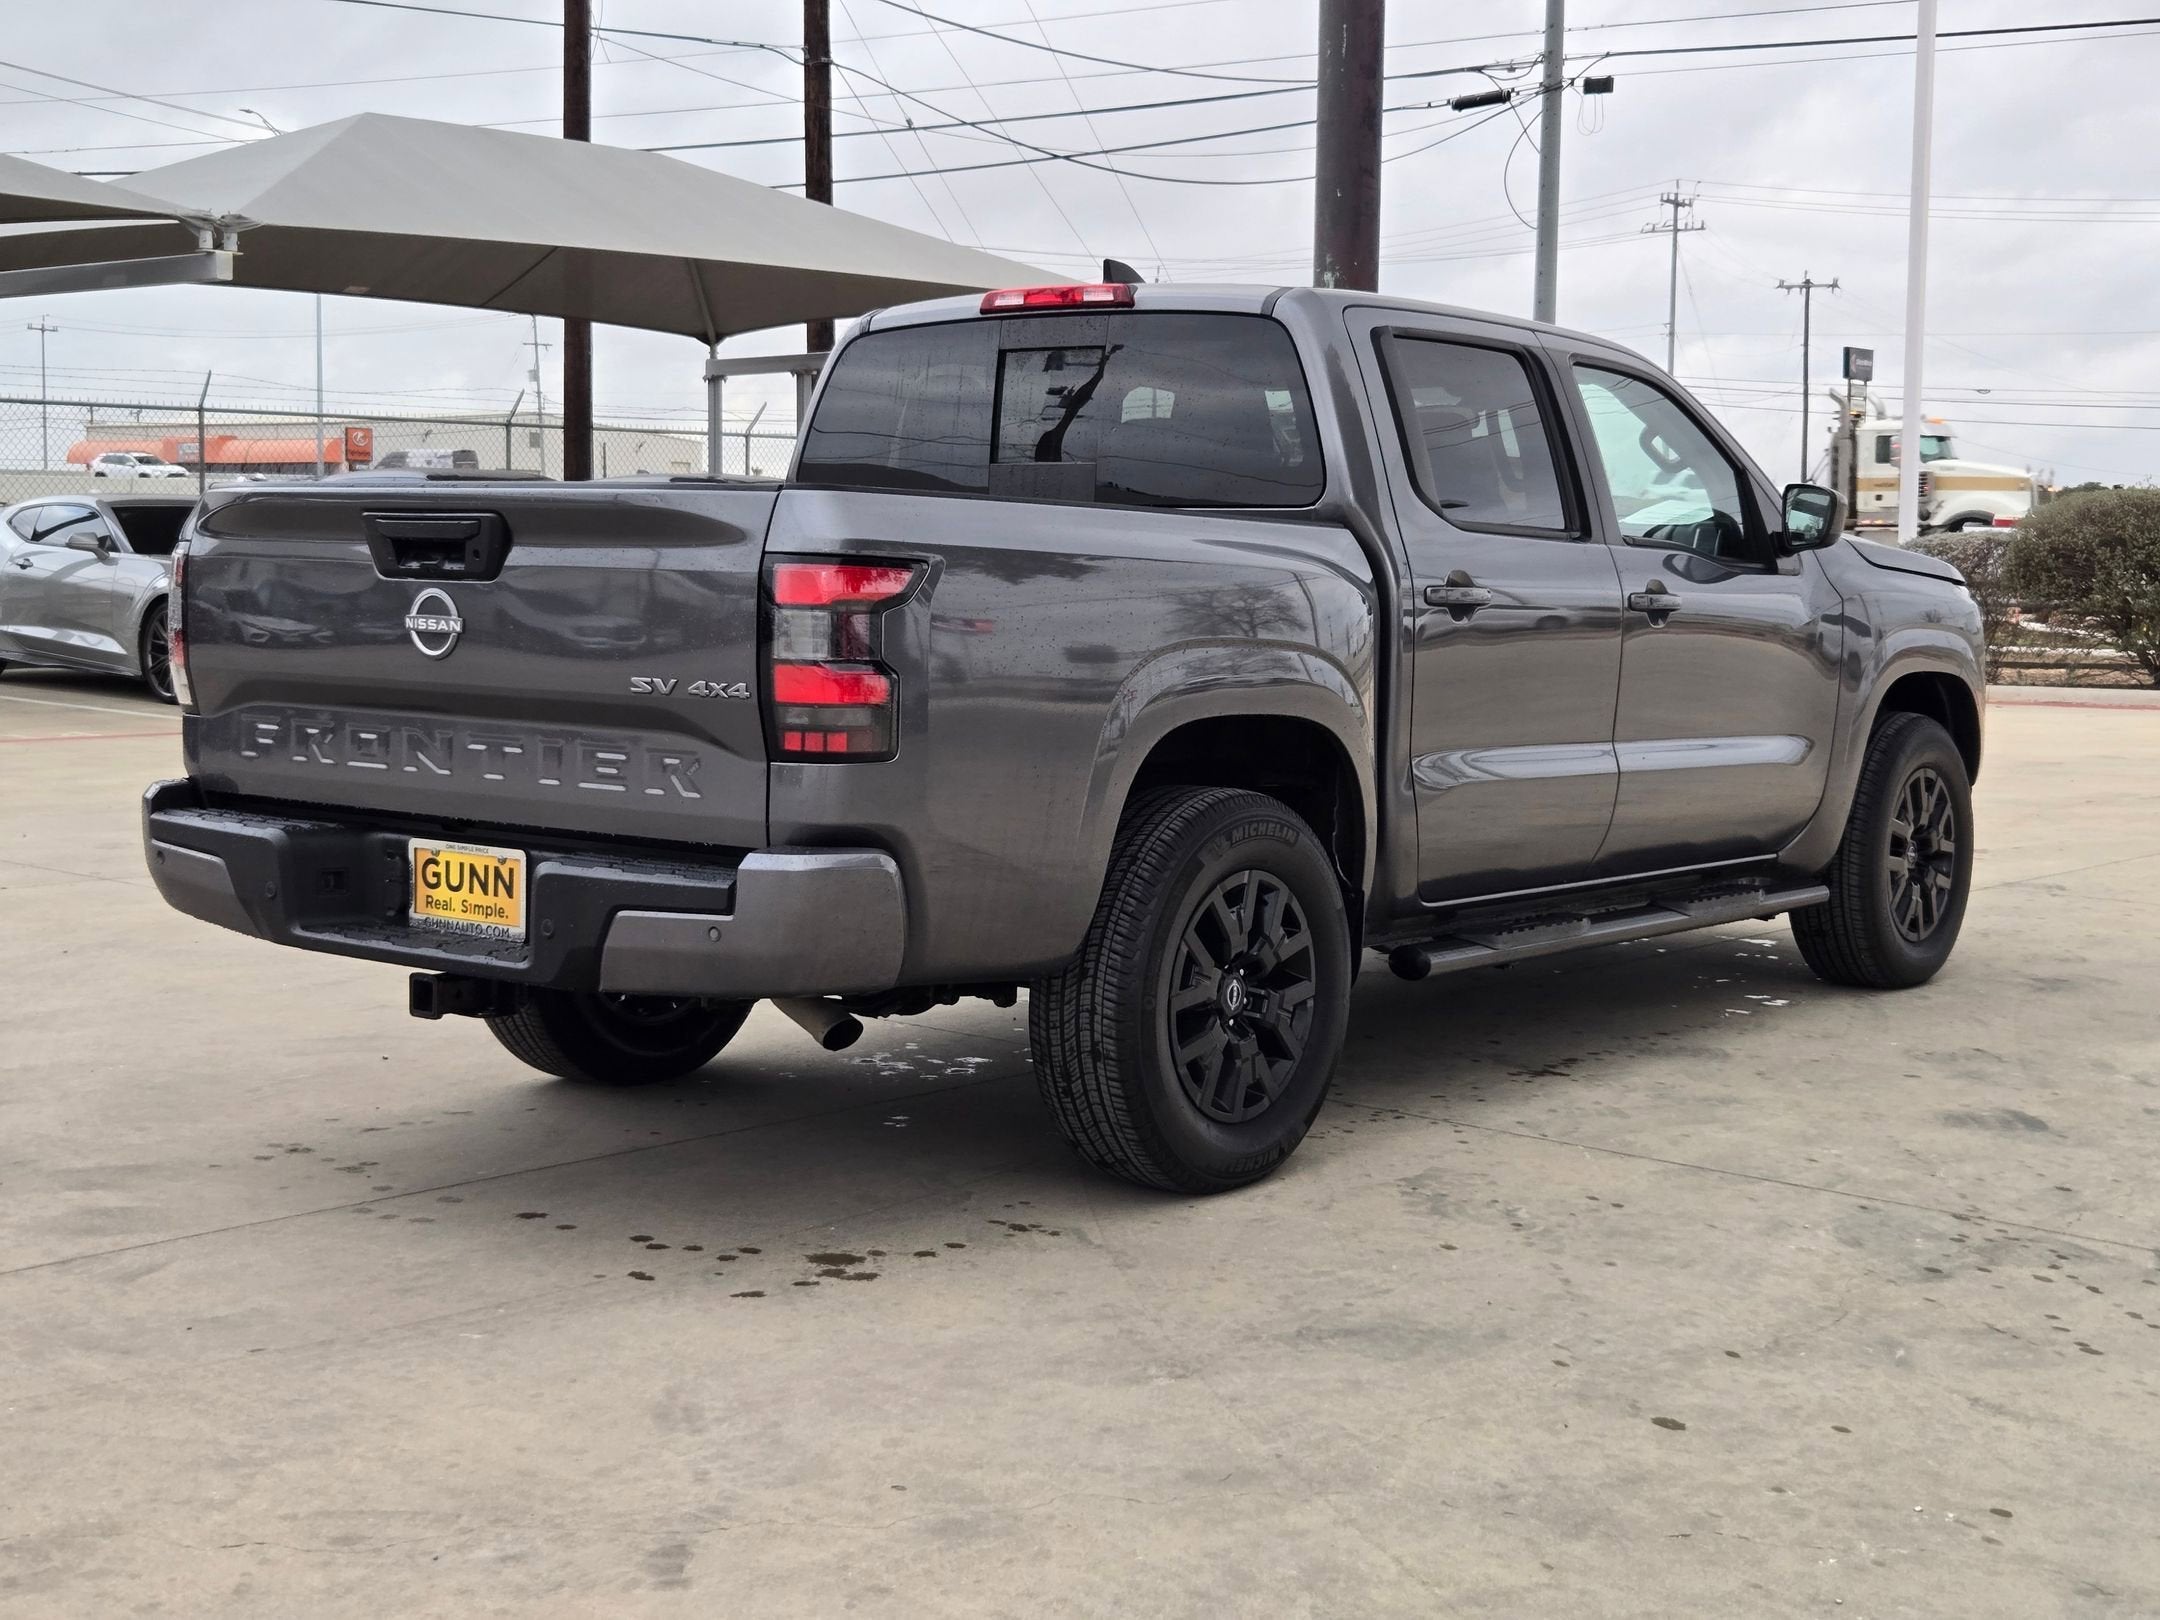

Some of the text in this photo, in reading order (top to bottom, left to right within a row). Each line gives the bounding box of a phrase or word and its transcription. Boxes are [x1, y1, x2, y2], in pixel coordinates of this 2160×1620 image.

[405, 617, 461, 632] NISSAN
[629, 675, 678, 695] SV
[240, 712, 702, 799] FRONTIER
[1231, 822, 1297, 844] MICHELIN
[421, 857, 515, 899] GUNN
[425, 894, 456, 912] Real.
